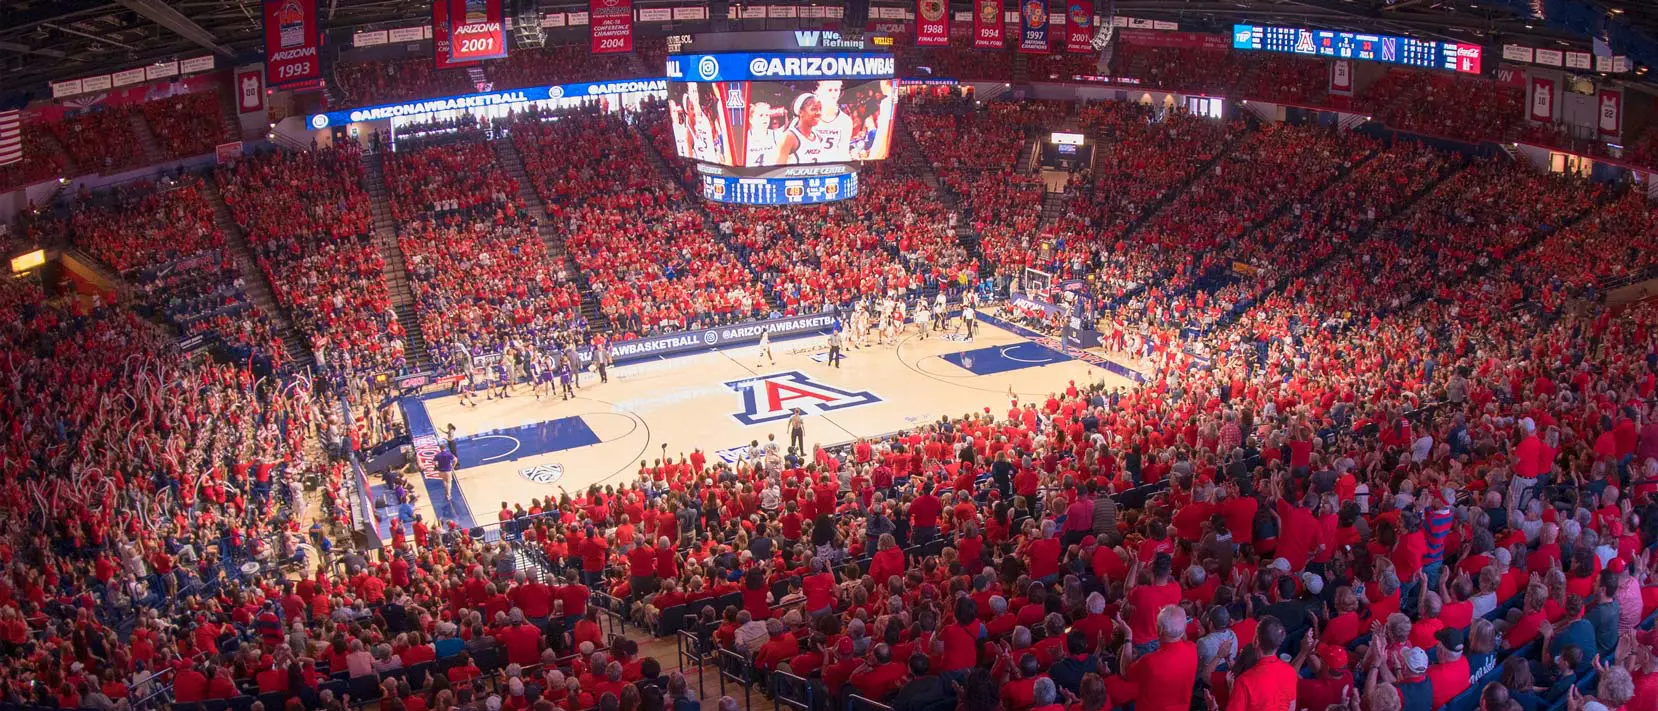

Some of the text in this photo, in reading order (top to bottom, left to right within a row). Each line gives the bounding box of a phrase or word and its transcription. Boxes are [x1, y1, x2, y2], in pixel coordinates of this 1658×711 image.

[454, 22, 500, 35] ARIZONA
[876, 23, 905, 33] NCAA
[923, 24, 943, 34] 1988
[980, 28, 999, 37] 1994
[1026, 31, 1044, 40] 1997
[1072, 33, 1089, 42] 2001
[461, 37, 494, 53] 2001
[600, 38, 625, 49] 2004
[822, 39, 864, 49] Refining
[270, 46, 316, 62] ARIZONA
[278, 62, 311, 78] 1993
[750, 58, 894, 76] @ARIZONAWBAS
[350, 92, 528, 122] @ARIZONAWBASKETBALL
[1604, 108, 1614, 119] 22
